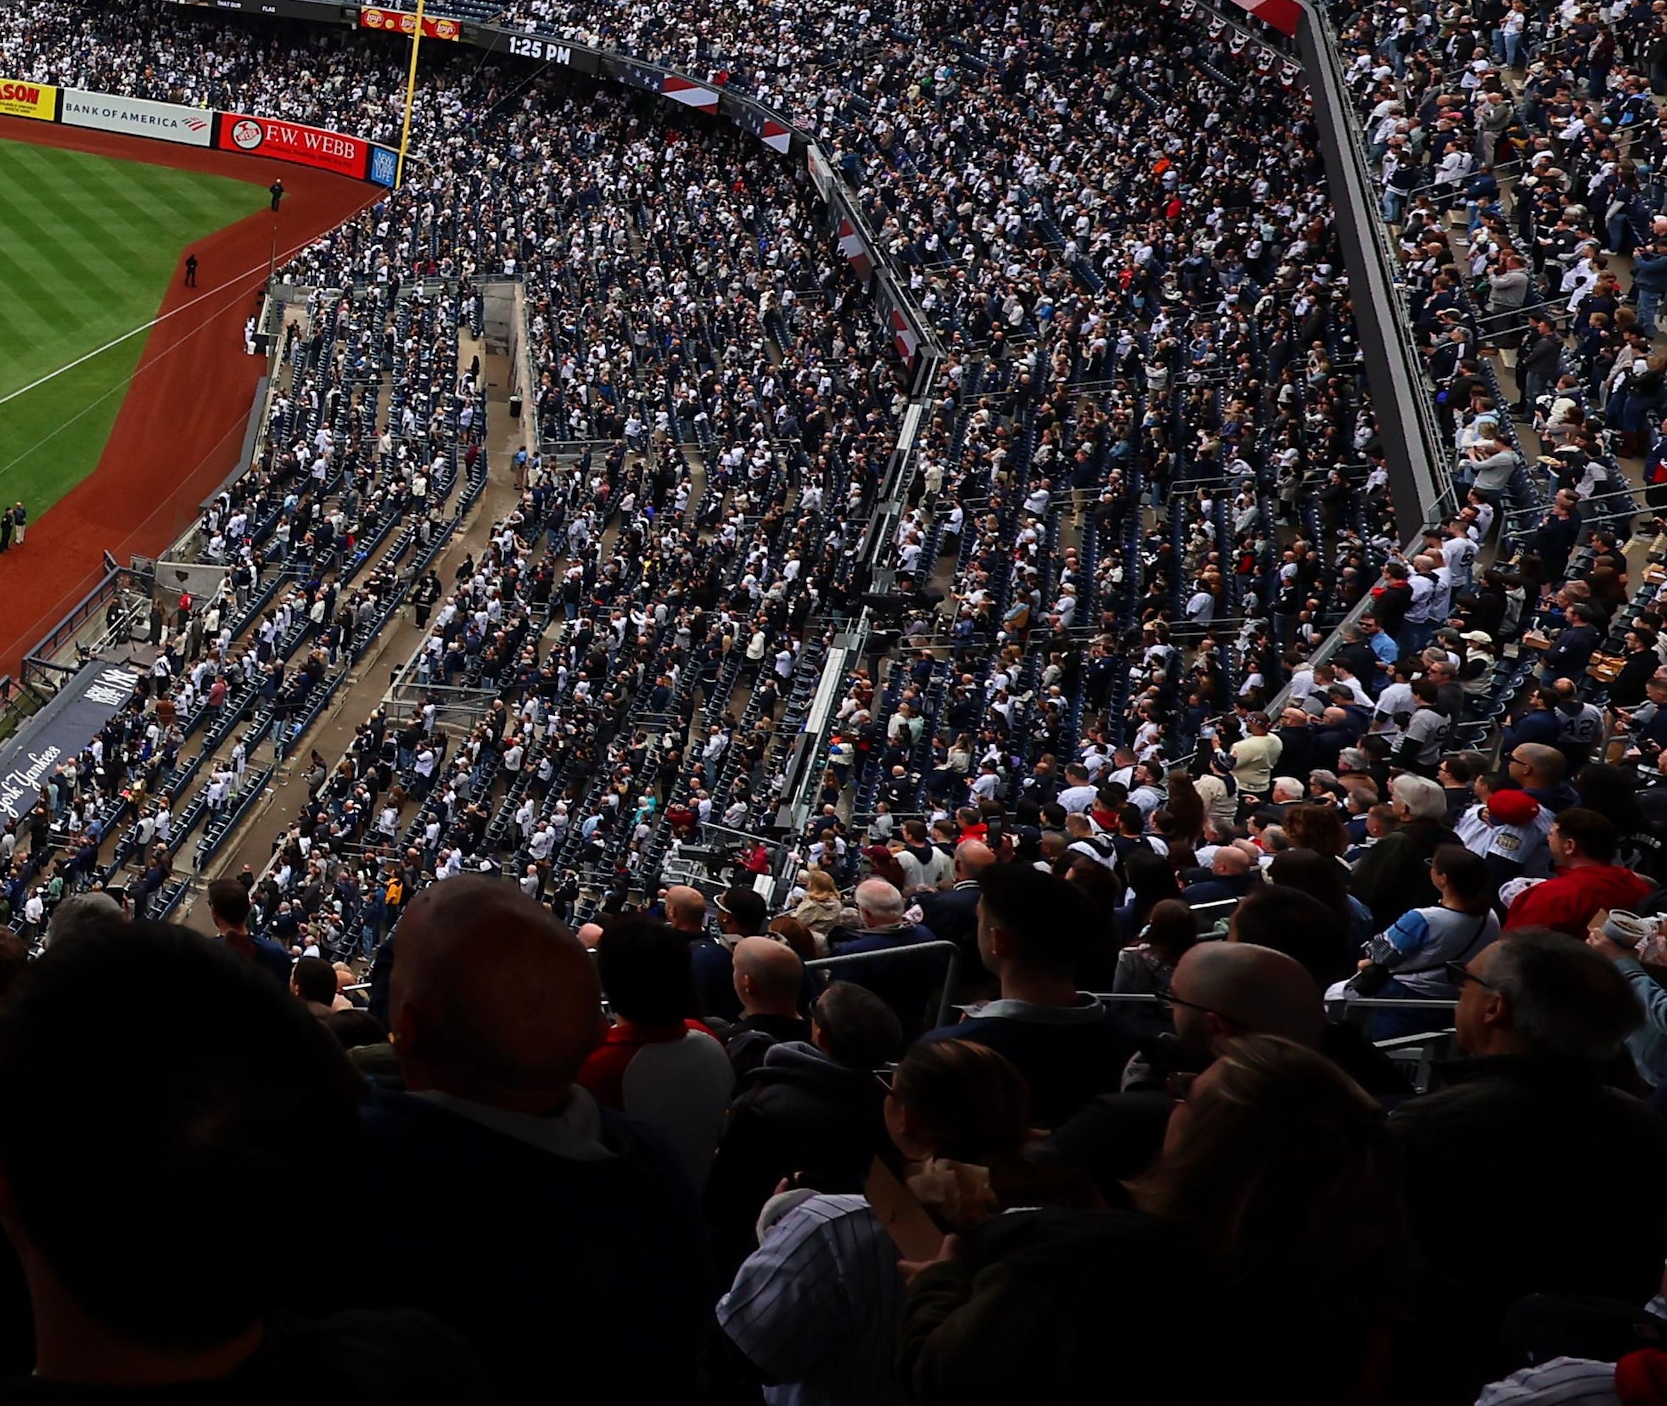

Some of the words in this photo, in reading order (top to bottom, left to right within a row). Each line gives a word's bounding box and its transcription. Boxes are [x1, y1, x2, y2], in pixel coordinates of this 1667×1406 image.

[509, 35, 543, 58] 1:25
[546, 46, 571, 65] PM
[65, 103, 98, 115] BANK
[102, 108, 118, 119] OF
[120, 111, 178, 129] AMERICA
[266, 124, 299, 147] F.W.
[303, 131, 356, 160] WEBB
[375, 170, 391, 182] LIFE
[9, 745, 62, 793] Yankees
